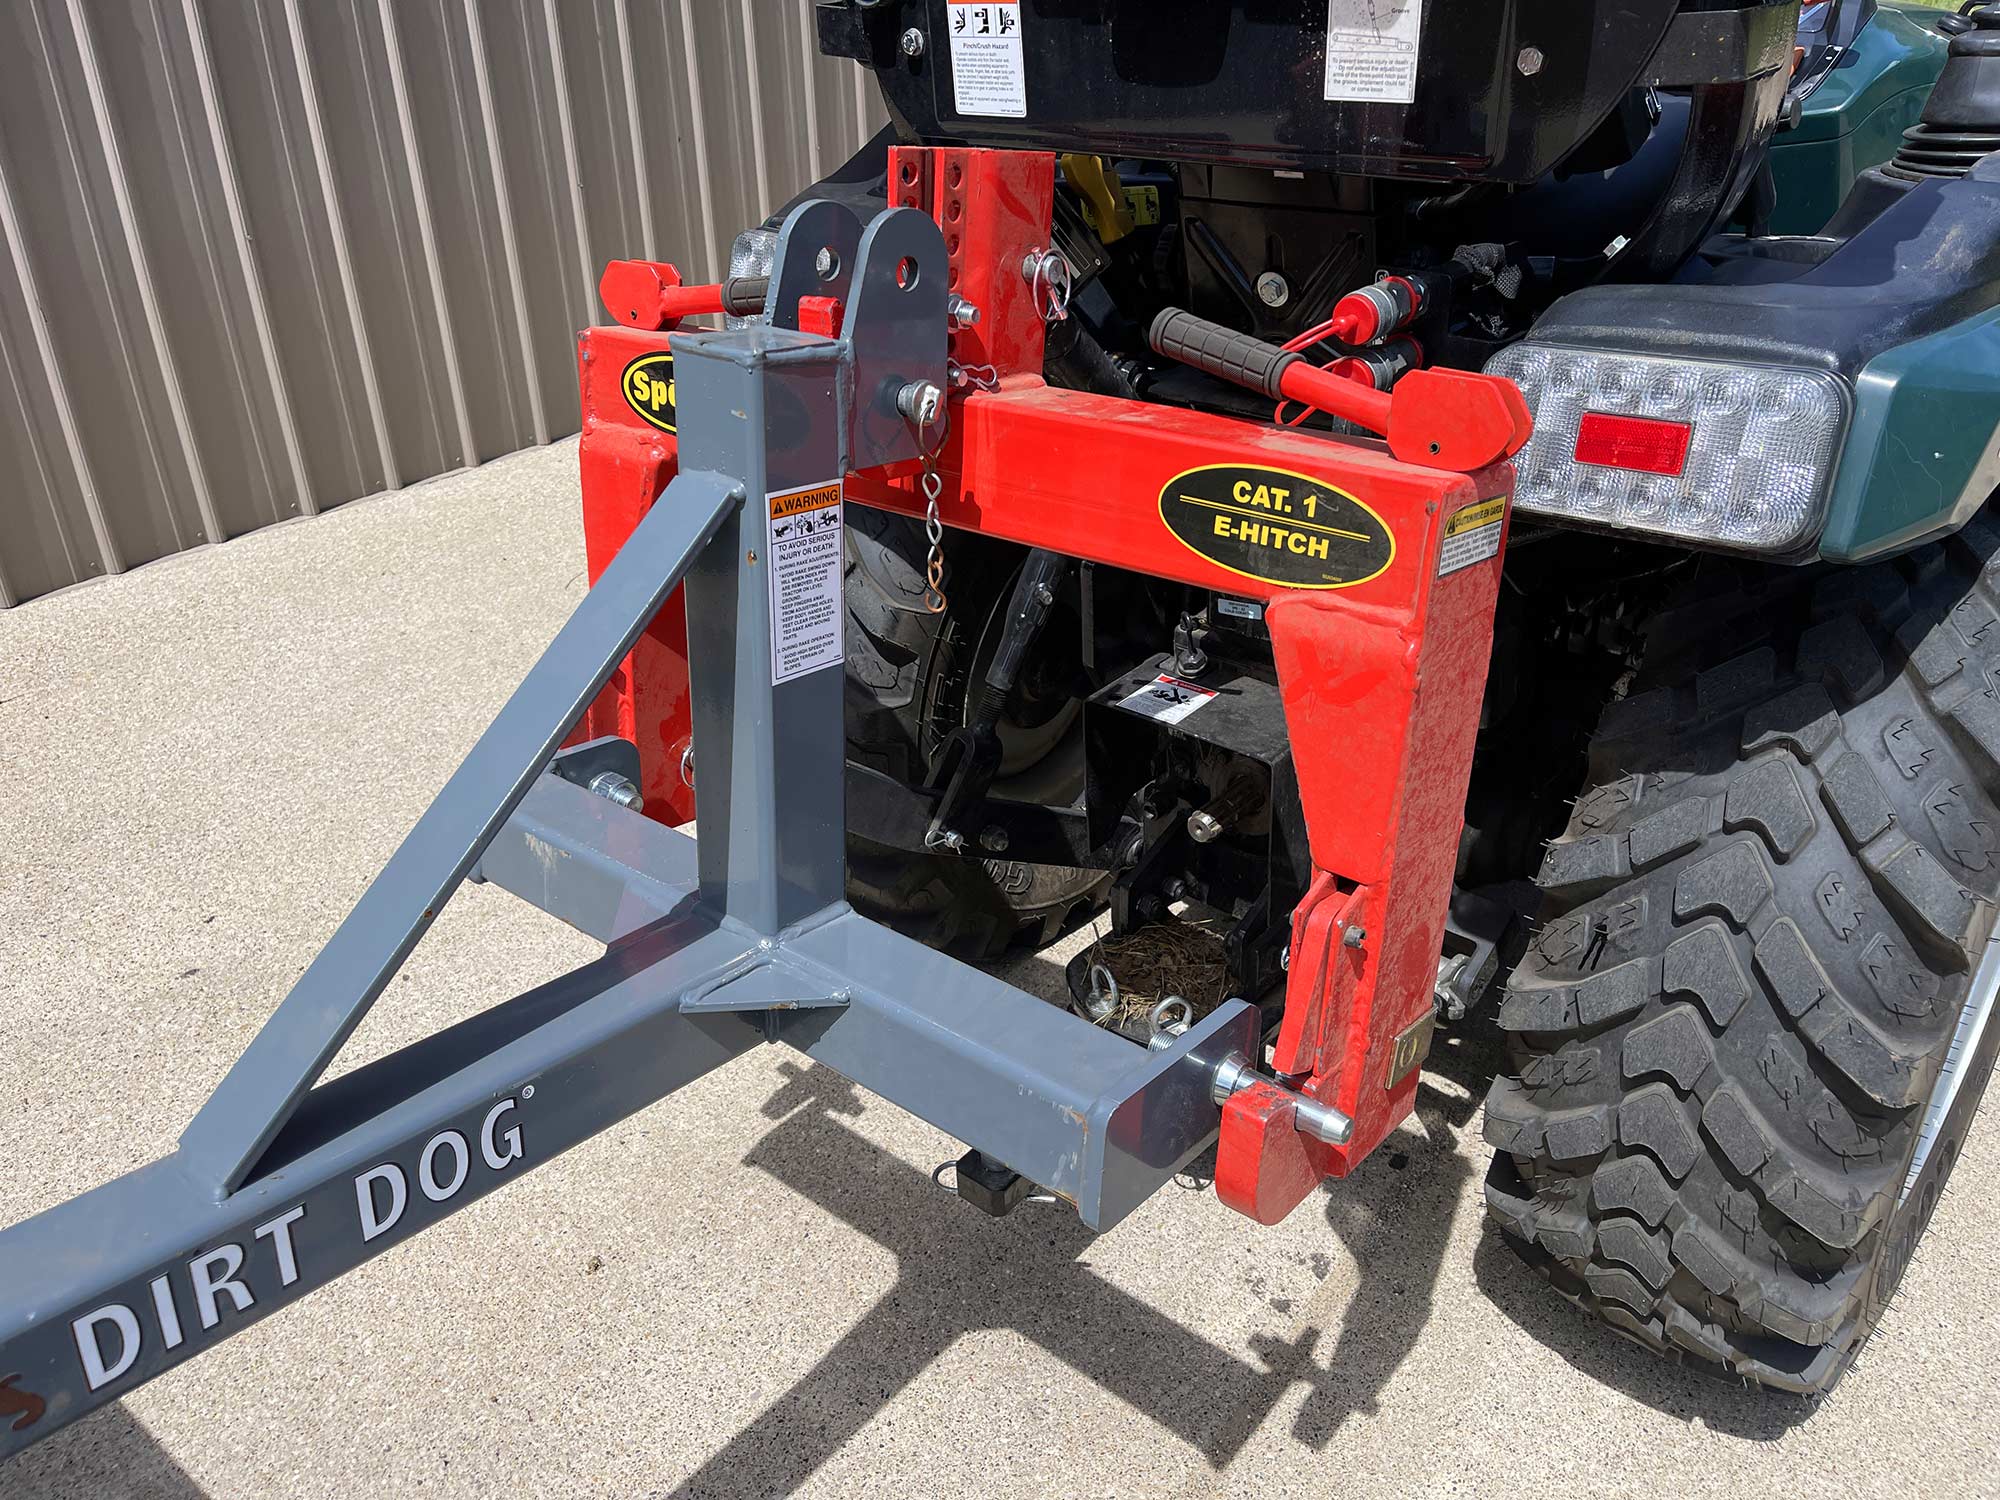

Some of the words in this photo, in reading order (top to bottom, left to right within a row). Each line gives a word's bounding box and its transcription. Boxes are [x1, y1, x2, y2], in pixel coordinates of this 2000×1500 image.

[784, 489, 838, 511] WARNING
[1233, 481, 1292, 513] CAT.
[1303, 495, 1317, 518] 1
[778, 544, 787, 552] TO
[788, 539, 807, 549] AVOID
[809, 533, 835, 544] SERIOUS
[779, 550, 801, 561] INJURY
[1213, 515, 1330, 560] E-HITCH
[354, 1097, 525, 1242] DOG
[70, 1205, 306, 1394] DIRT
